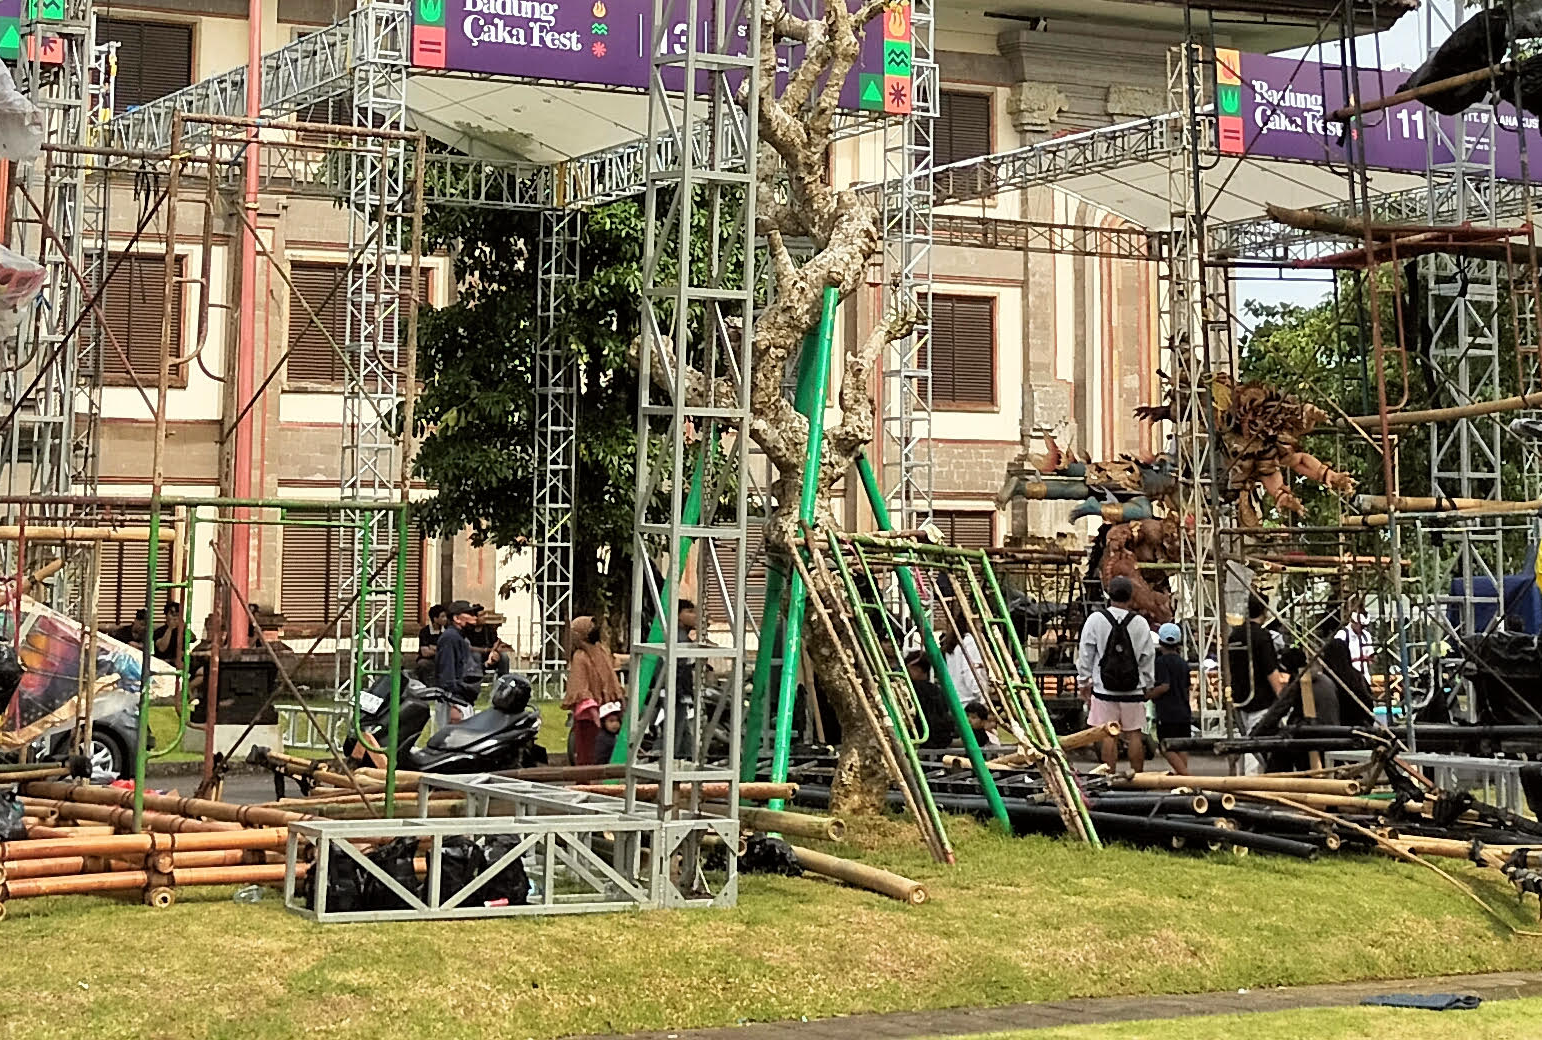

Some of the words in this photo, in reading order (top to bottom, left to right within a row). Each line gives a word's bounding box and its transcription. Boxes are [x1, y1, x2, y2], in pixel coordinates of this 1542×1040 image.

[463, 15, 527, 46] Çaka
[529, 22, 582, 51] Fest
[1252, 80, 1324, 116] Badung
[1397, 109, 1424, 140] 11
